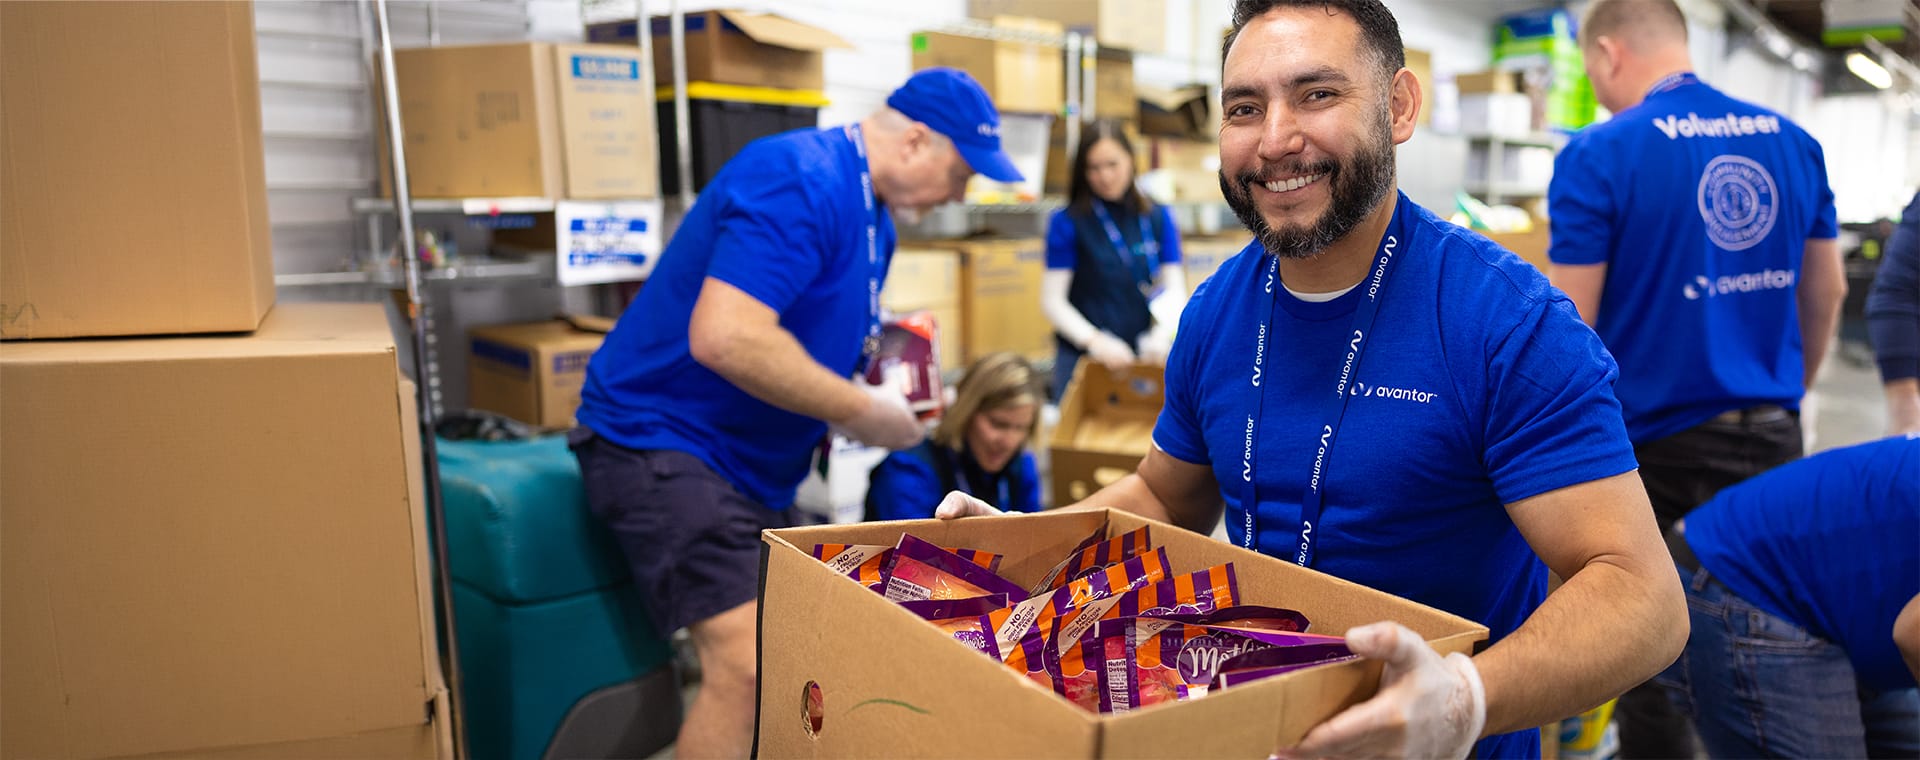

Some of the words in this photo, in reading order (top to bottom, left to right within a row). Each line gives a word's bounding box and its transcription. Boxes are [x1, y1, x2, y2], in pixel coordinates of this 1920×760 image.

[1653, 112, 1780, 140] Volunteer
[1368, 256, 1388, 301] avantor
[1715, 268, 1795, 295] avantor
[1256, 324, 1266, 365] avantor
[1337, 352, 1355, 397] avantor
[1376, 386, 1434, 403] avantor
[1244, 418, 1254, 460] avantor
[1311, 447, 1325, 491] avantor
[1244, 512, 1252, 550] vantor
[837, 554, 849, 565] NO
[1009, 613, 1021, 627] NO
[1076, 613, 1087, 625] NO
